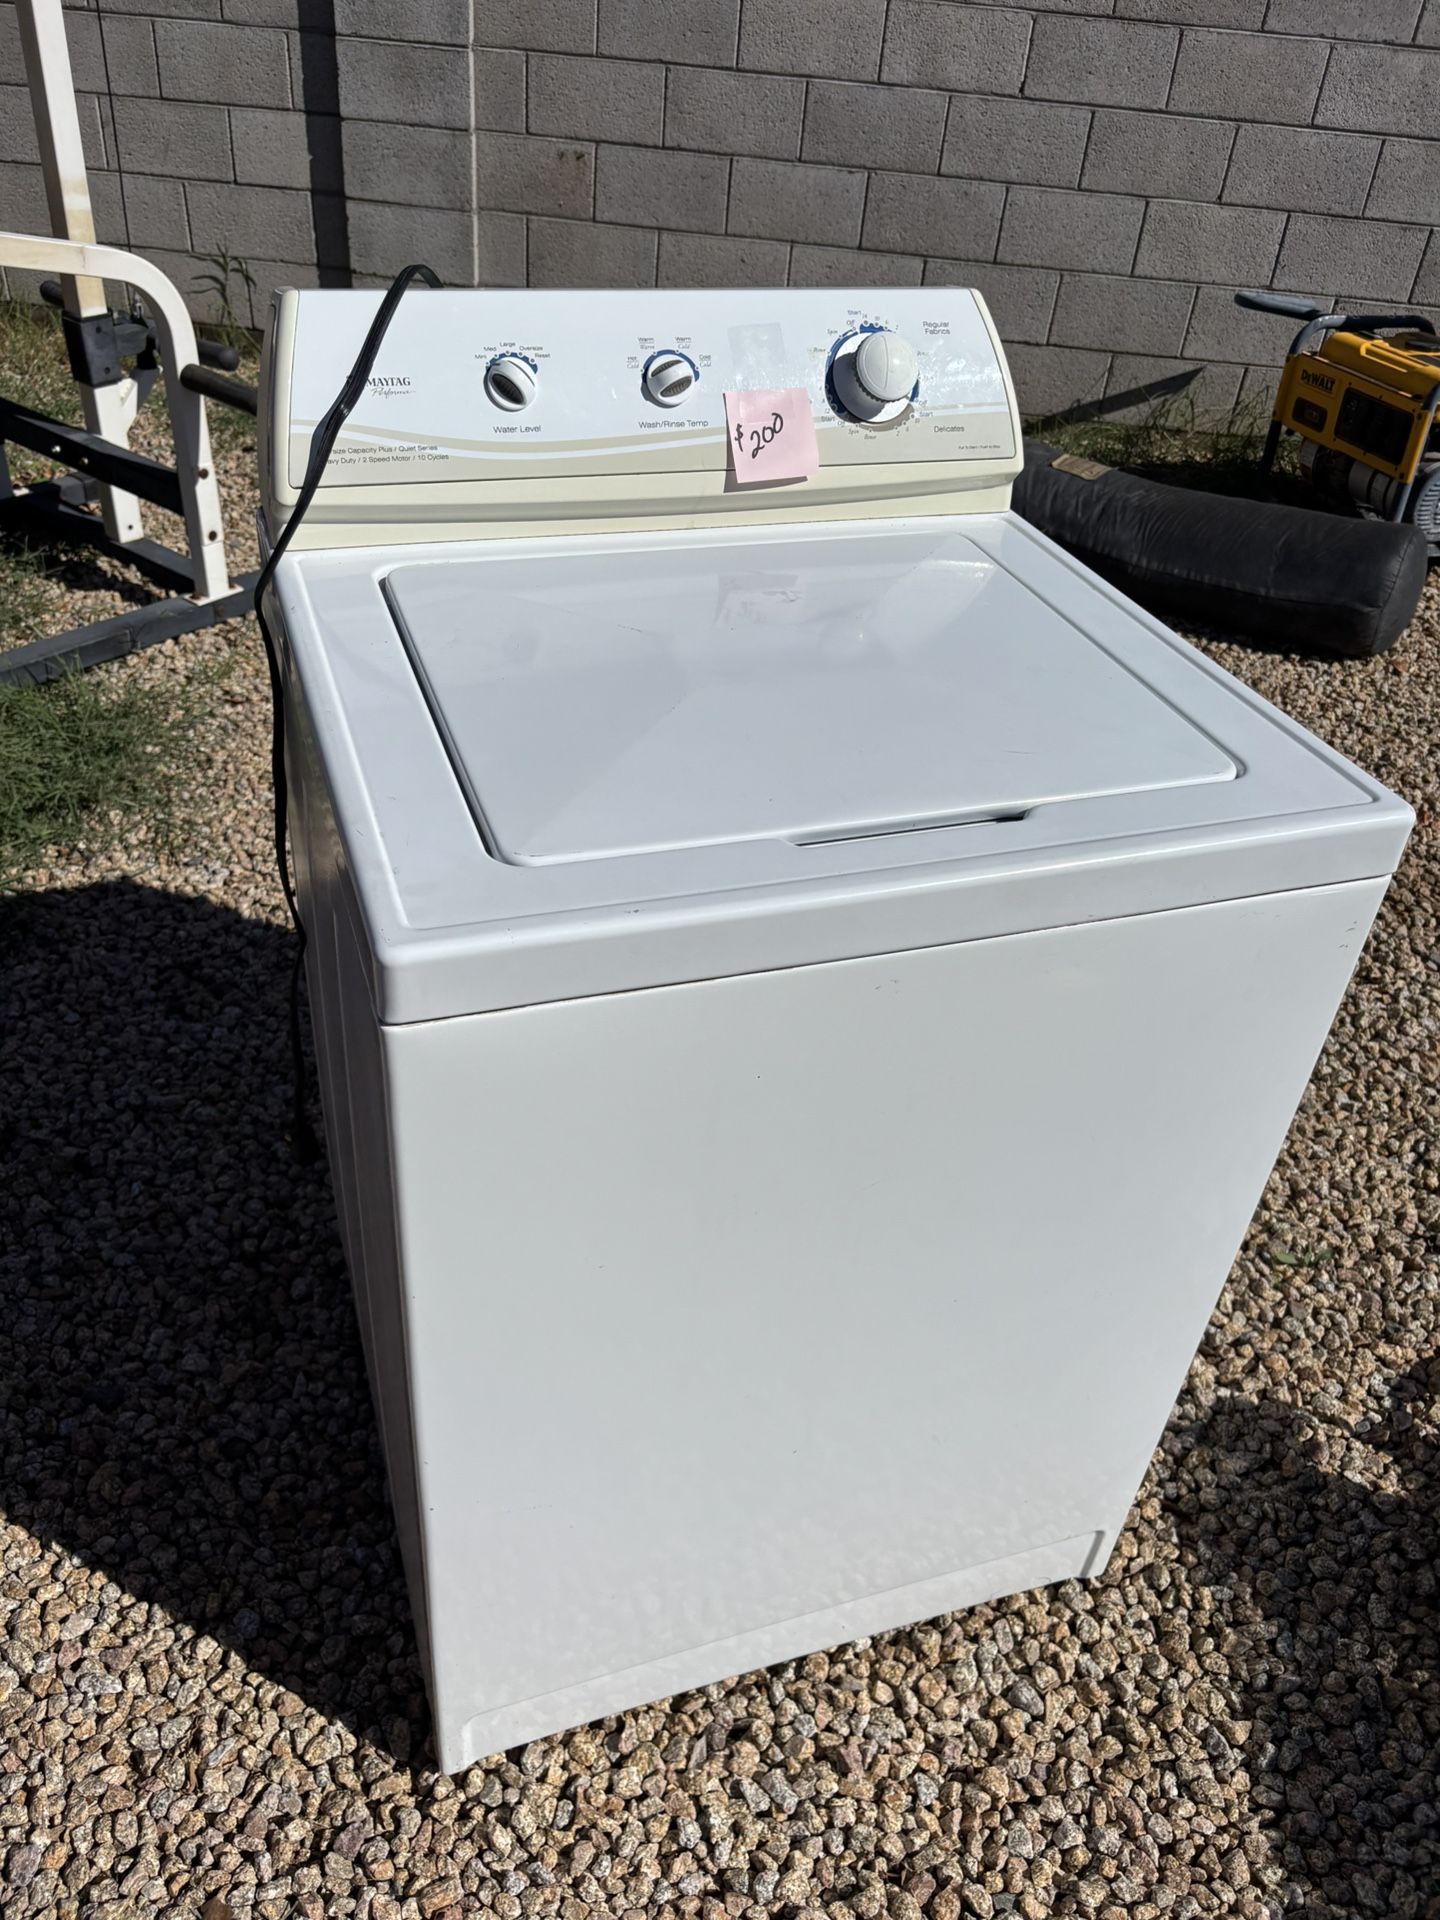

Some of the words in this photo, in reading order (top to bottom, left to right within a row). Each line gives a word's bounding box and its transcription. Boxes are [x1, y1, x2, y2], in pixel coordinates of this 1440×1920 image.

[923, 321, 949, 329] Regular
[366, 377, 411, 387] MAYTAG
[638, 420, 685, 429] Wash/Rinse
[687, 419, 709, 428] Temp
[933, 425, 965, 433] Delicates
[493, 426, 518, 434] Water
[519, 425, 541, 433] Level
[347, 446, 377, 456] Capacity
[378, 446, 393, 454] Plus
[417, 444, 438, 452] Series
[341, 456, 357, 465] Duty
[368, 456, 391, 464] Speed
[427, 453, 449, 462] Cycles
